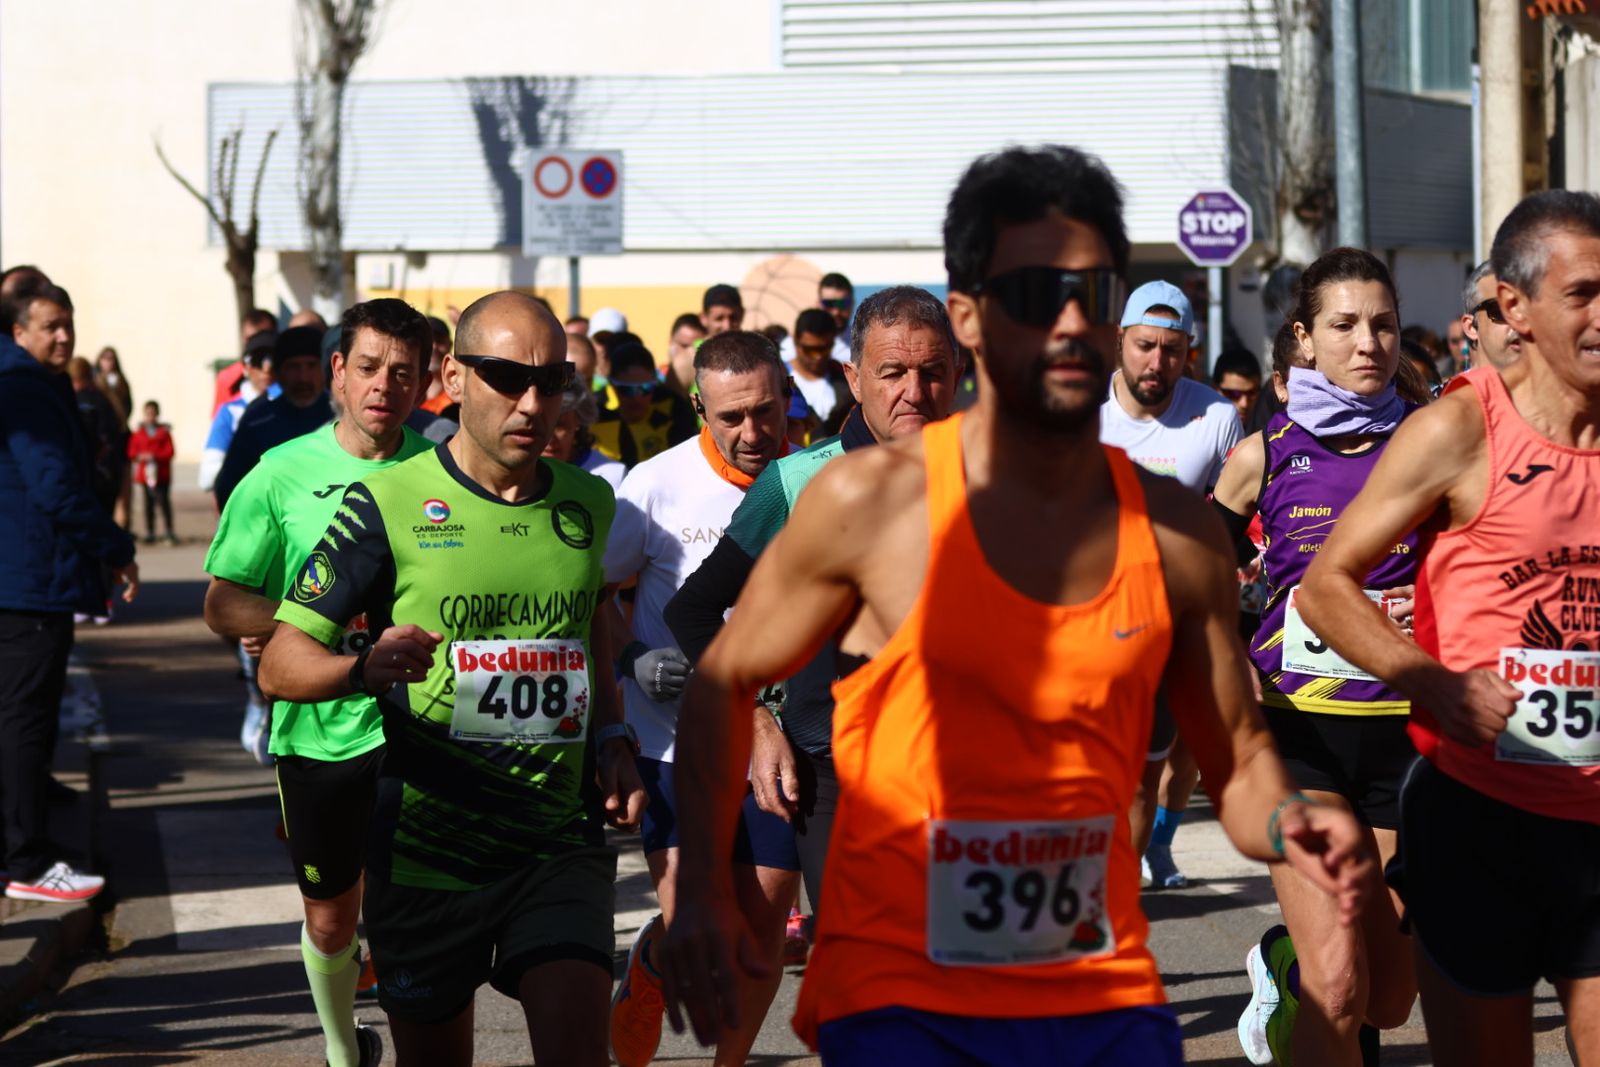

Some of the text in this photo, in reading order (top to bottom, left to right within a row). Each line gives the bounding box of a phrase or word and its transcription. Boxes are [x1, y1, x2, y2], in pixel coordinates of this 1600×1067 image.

[1182, 211, 1245, 234] STOP
[1289, 504, 1332, 518] Jamón
[412, 524, 465, 533] CARBAJOSA
[1499, 559, 1541, 590] BAR
[1547, 547, 1570, 568] LA
[457, 646, 585, 672] bedunia
[1505, 656, 1600, 687] bedu
[477, 675, 568, 719] 408
[1526, 690, 1600, 739] 35
[934, 828, 1107, 865] bedunia
[963, 864, 1080, 932] 396
